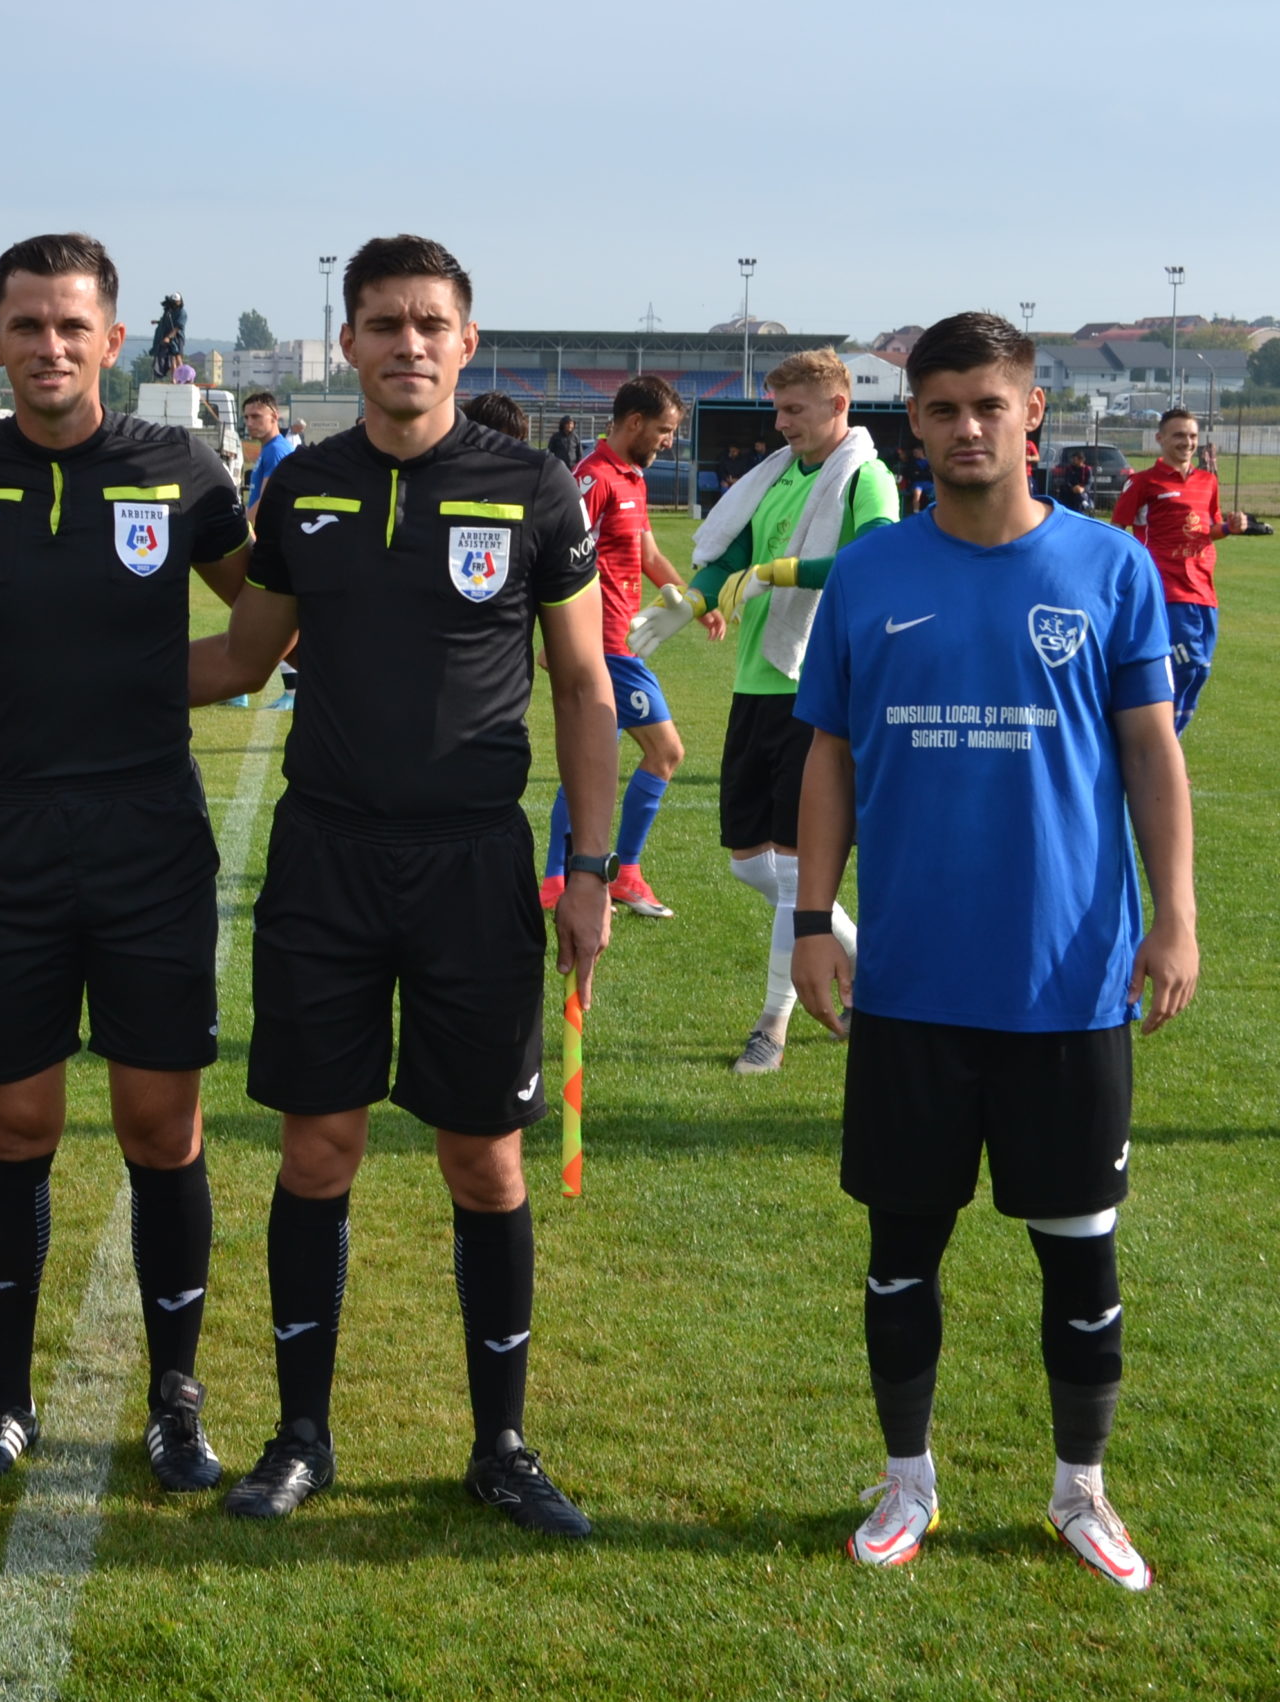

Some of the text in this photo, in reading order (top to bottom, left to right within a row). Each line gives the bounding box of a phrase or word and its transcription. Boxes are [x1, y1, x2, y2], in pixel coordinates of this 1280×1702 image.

[121, 509, 163, 520] ARBITRU
[136, 535, 148, 545] FRF
[460, 531, 501, 541] ARBITRU
[457, 540, 502, 549] ASISTENT
[472, 562, 486, 572] FRF
[630, 690, 650, 719] 9
[886, 705, 943, 724] CONSILIUL
[945, 705, 982, 724] LOCAL
[1000, 704, 1058, 727] PRIMĂRIA
[912, 729, 957, 748] SIGHETU
